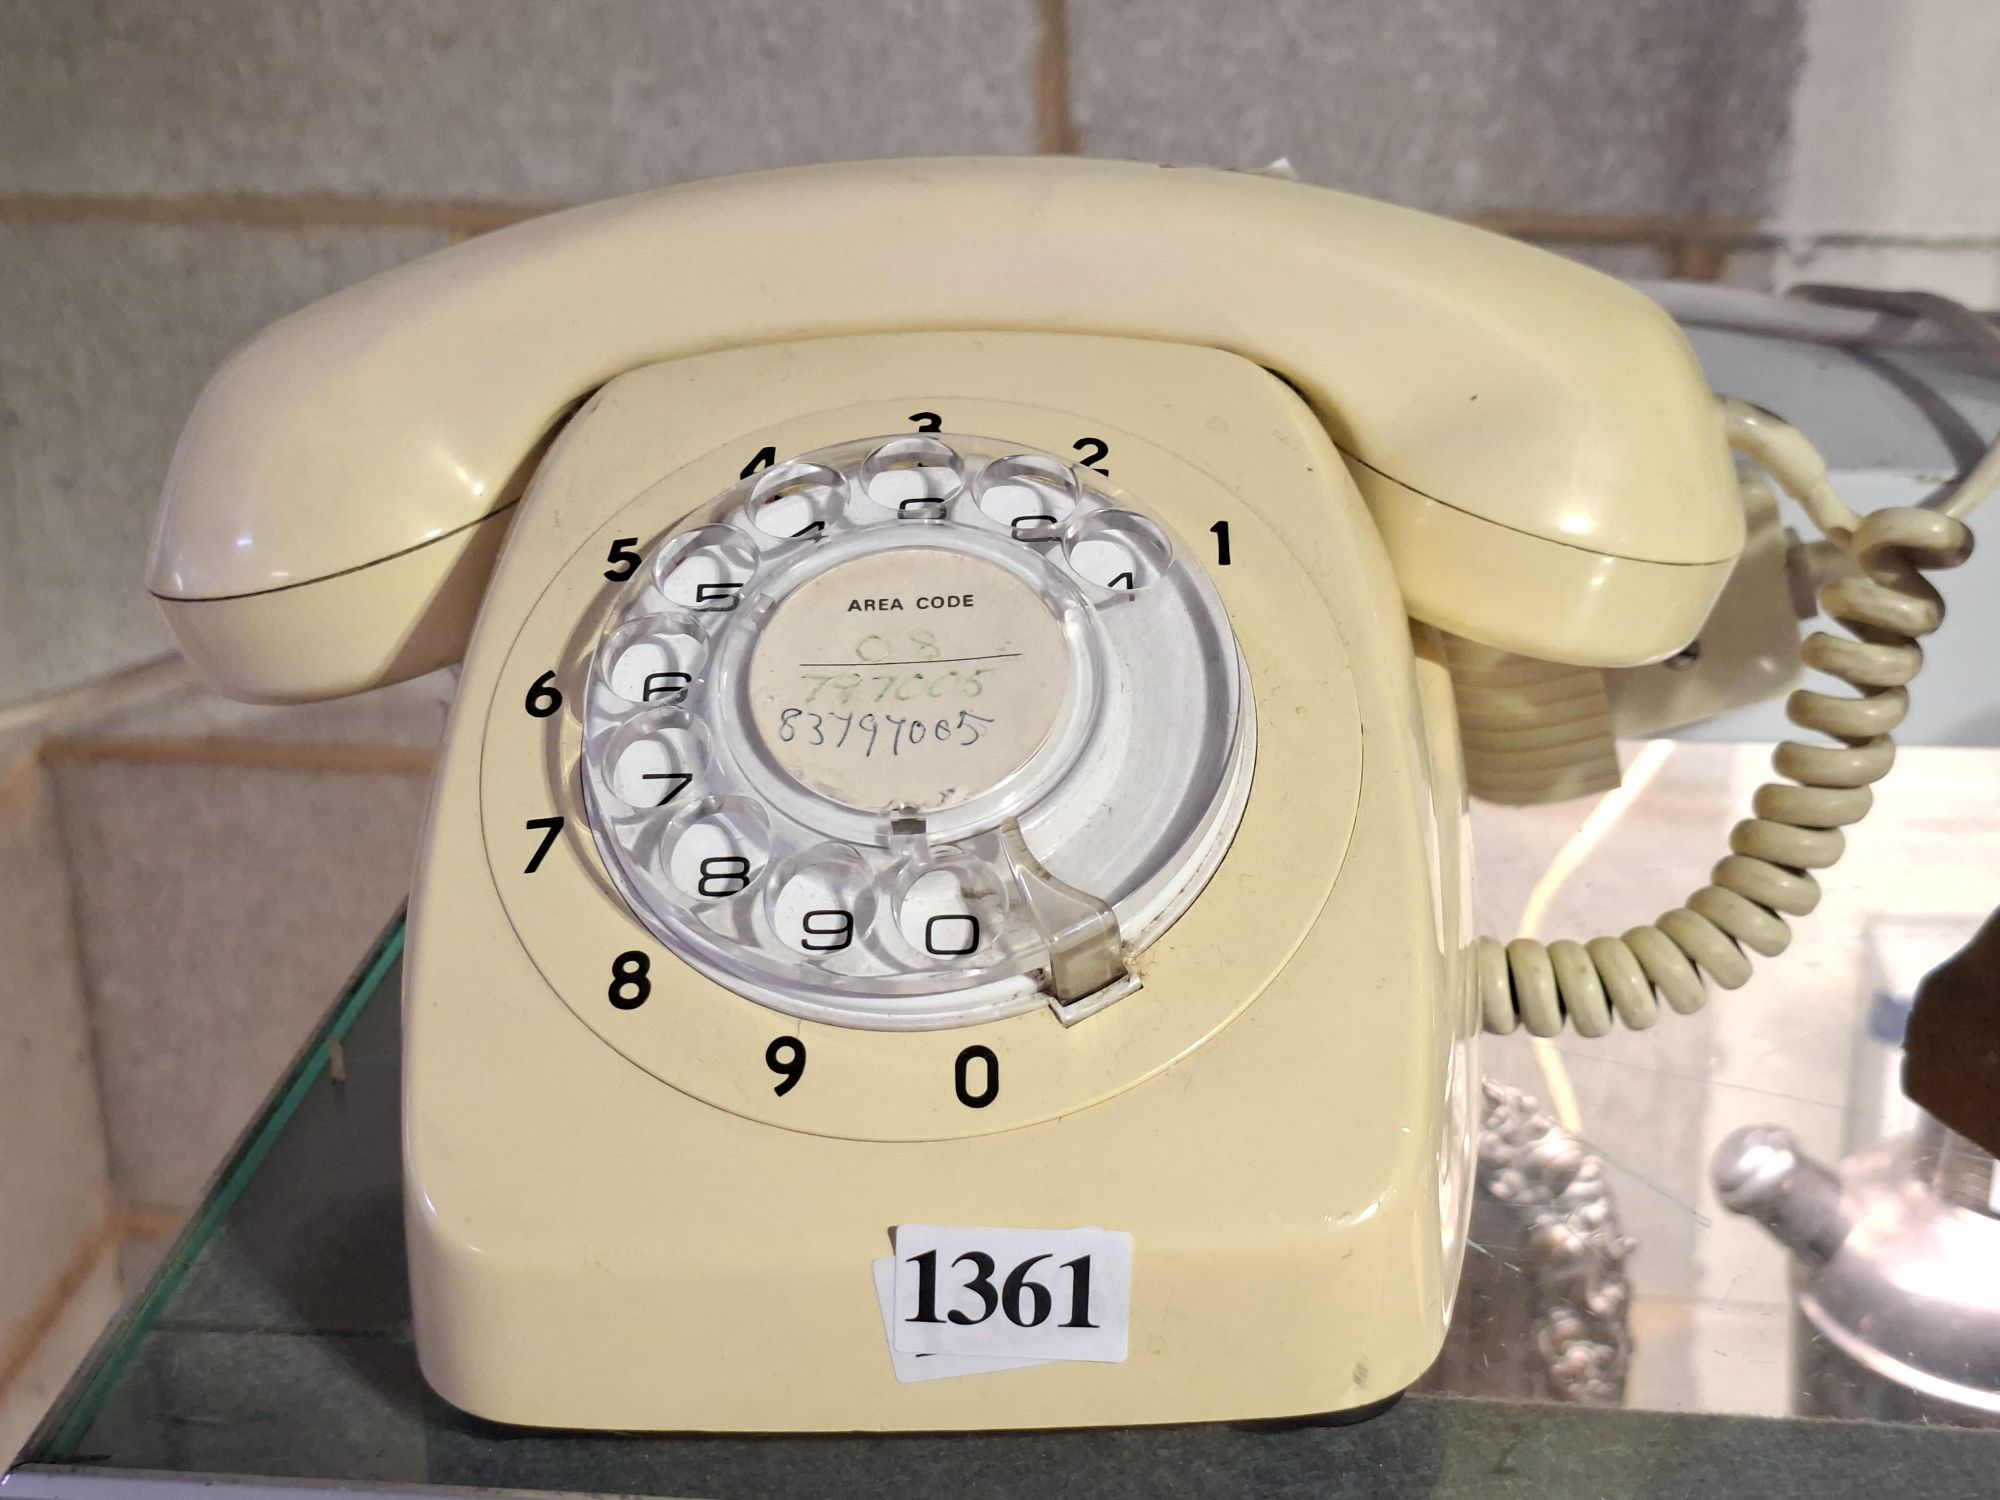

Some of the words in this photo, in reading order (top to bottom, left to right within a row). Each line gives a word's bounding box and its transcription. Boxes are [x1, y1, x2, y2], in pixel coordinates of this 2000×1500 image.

[1072, 437, 1110, 477] 2
[604, 537, 643, 582] 5
[1209, 520, 1232, 566] 1
[847, 598, 904, 613] AREA
[916, 594, 975, 610] CODE
[525, 670, 563, 719] 6
[642, 773, 693, 807] 7
[523, 816, 566, 874] 7
[697, 856, 751, 897] 8
[801, 909, 855, 951] 9
[925, 914, 980, 956] 0
[607, 950, 651, 1011] 8
[765, 1035, 807, 1098] 9
[955, 1044, 999, 1110] 0
[904, 1248, 1100, 1328] 1361
